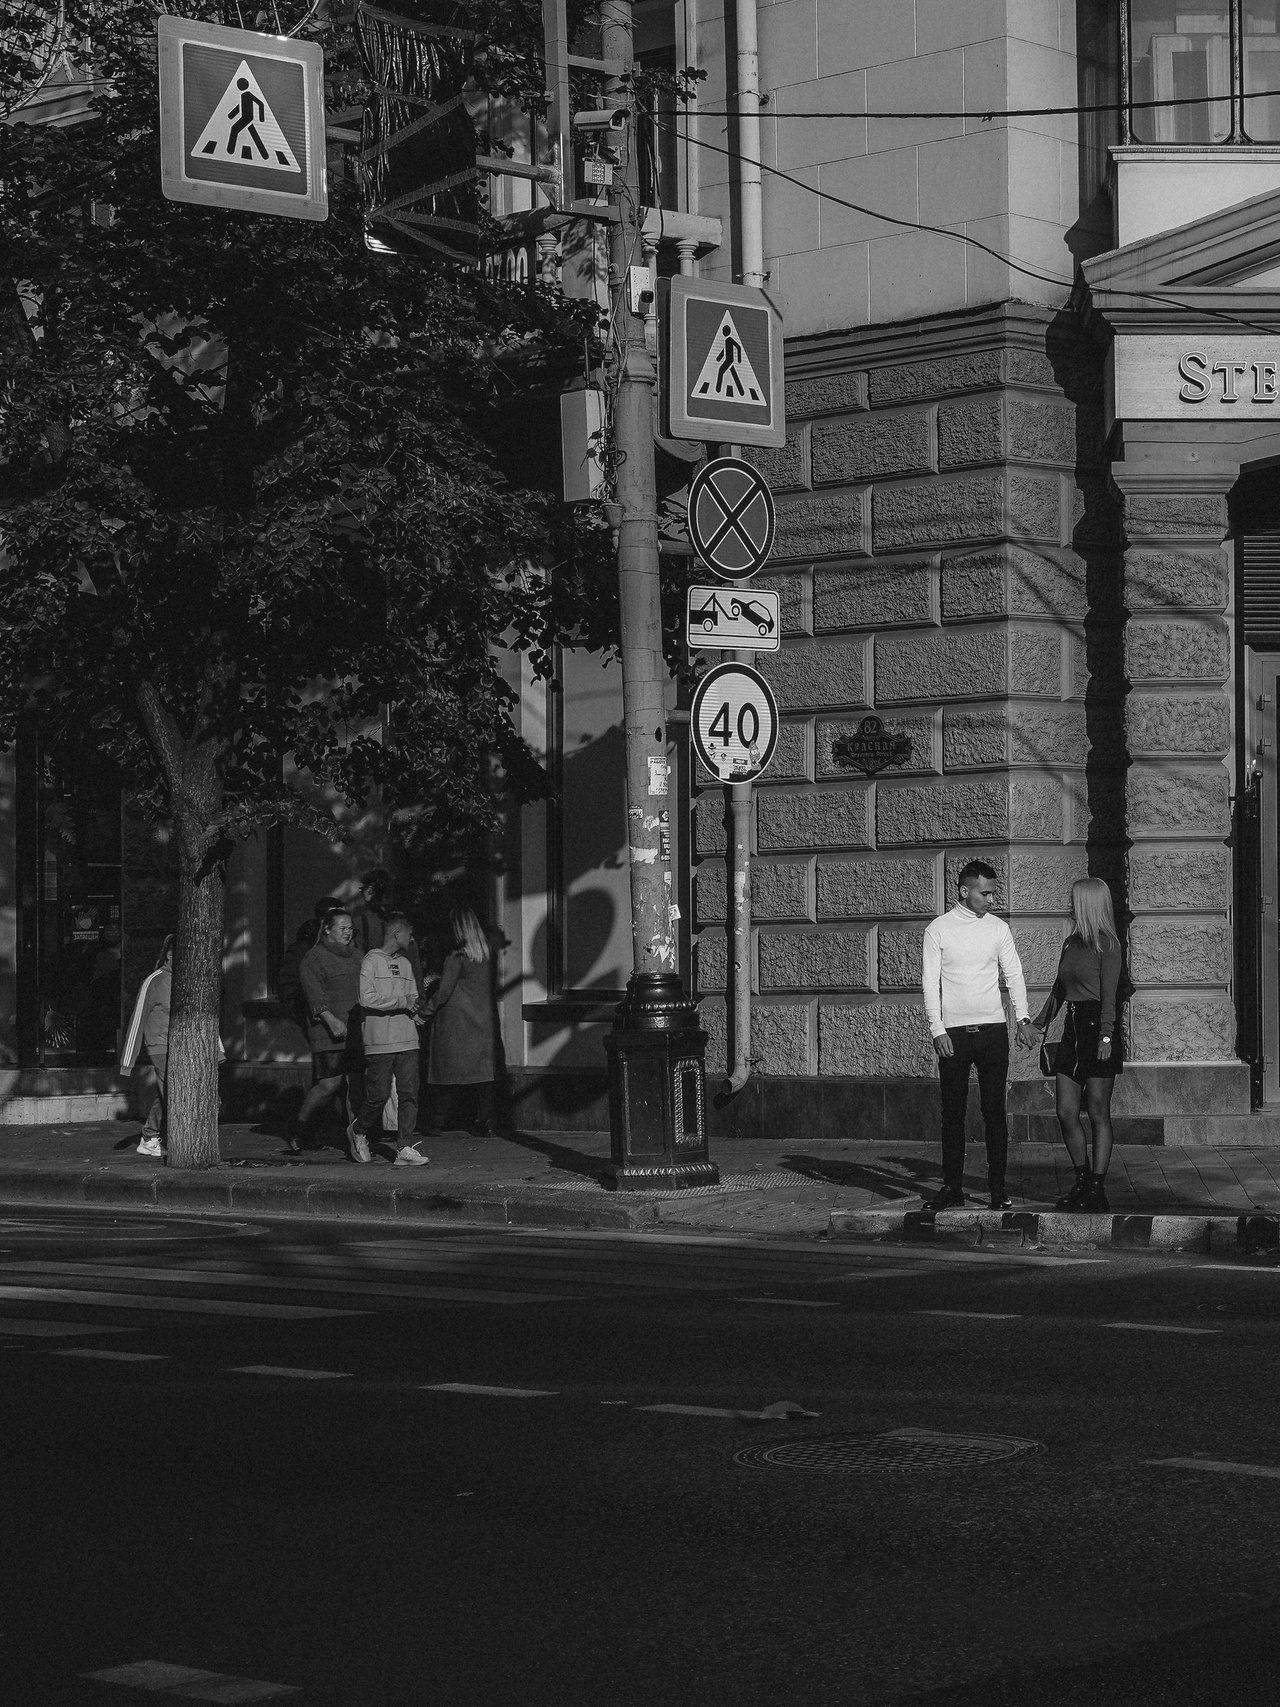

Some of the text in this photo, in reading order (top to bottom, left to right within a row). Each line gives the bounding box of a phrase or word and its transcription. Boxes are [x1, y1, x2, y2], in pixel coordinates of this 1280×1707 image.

[708, 702, 760, 749] 40
[863, 720, 877, 734] 82
[847, 741, 896, 752] КРАСНАЯ
